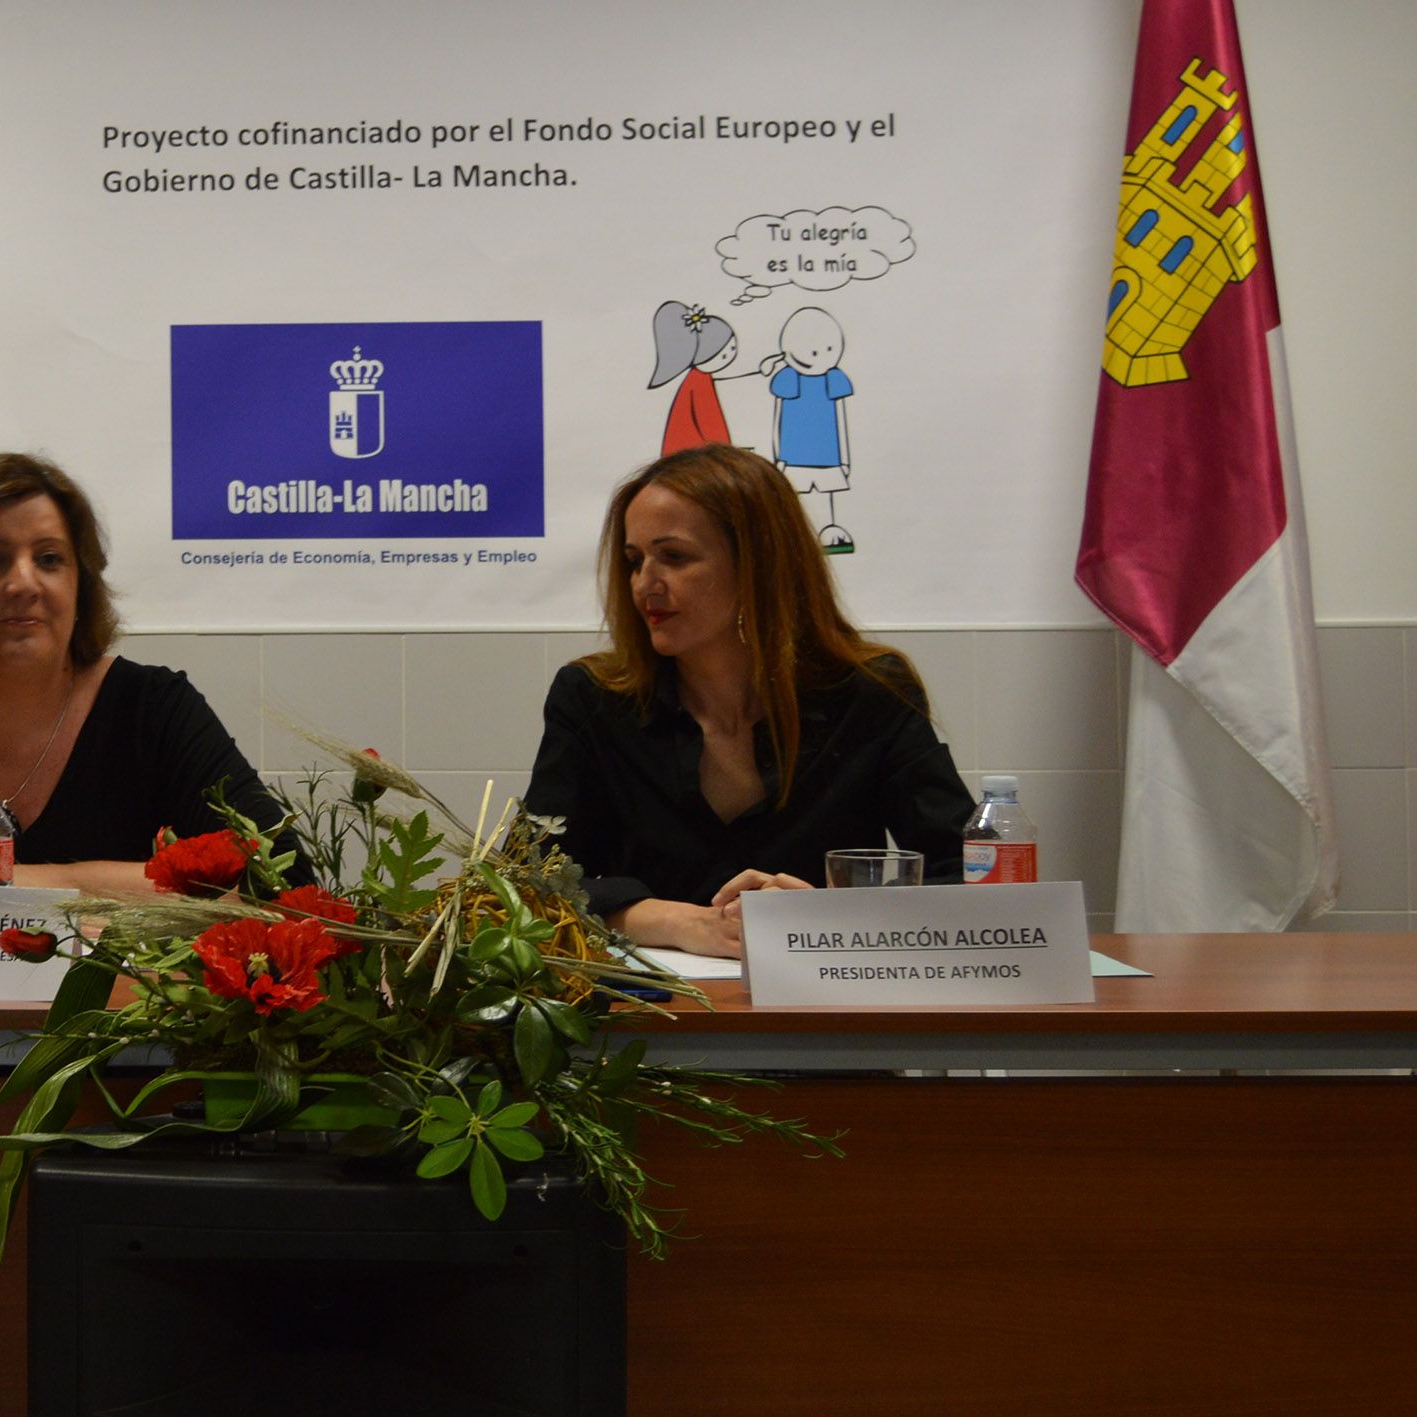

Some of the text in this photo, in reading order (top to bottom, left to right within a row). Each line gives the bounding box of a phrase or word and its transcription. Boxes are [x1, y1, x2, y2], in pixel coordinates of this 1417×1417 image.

[103, 112, 895, 154] Proyecto cofinanciado por el Fondo Social Europeo y el
[102, 162, 577, 194] Gobierno de Castilla- La Mancha.
[766, 221, 868, 247] Tu alegría
[766, 252, 858, 273] es la mía
[226, 478, 490, 516] Castilla-La Mancha
[180, 549, 538, 568] Consejería de Economía, Empresas y Empleo
[787, 926, 1047, 948] PILAR ALARCÓN ALCOLEA
[819, 964, 1022, 980] PRESIDENTA DE AFYMOS
